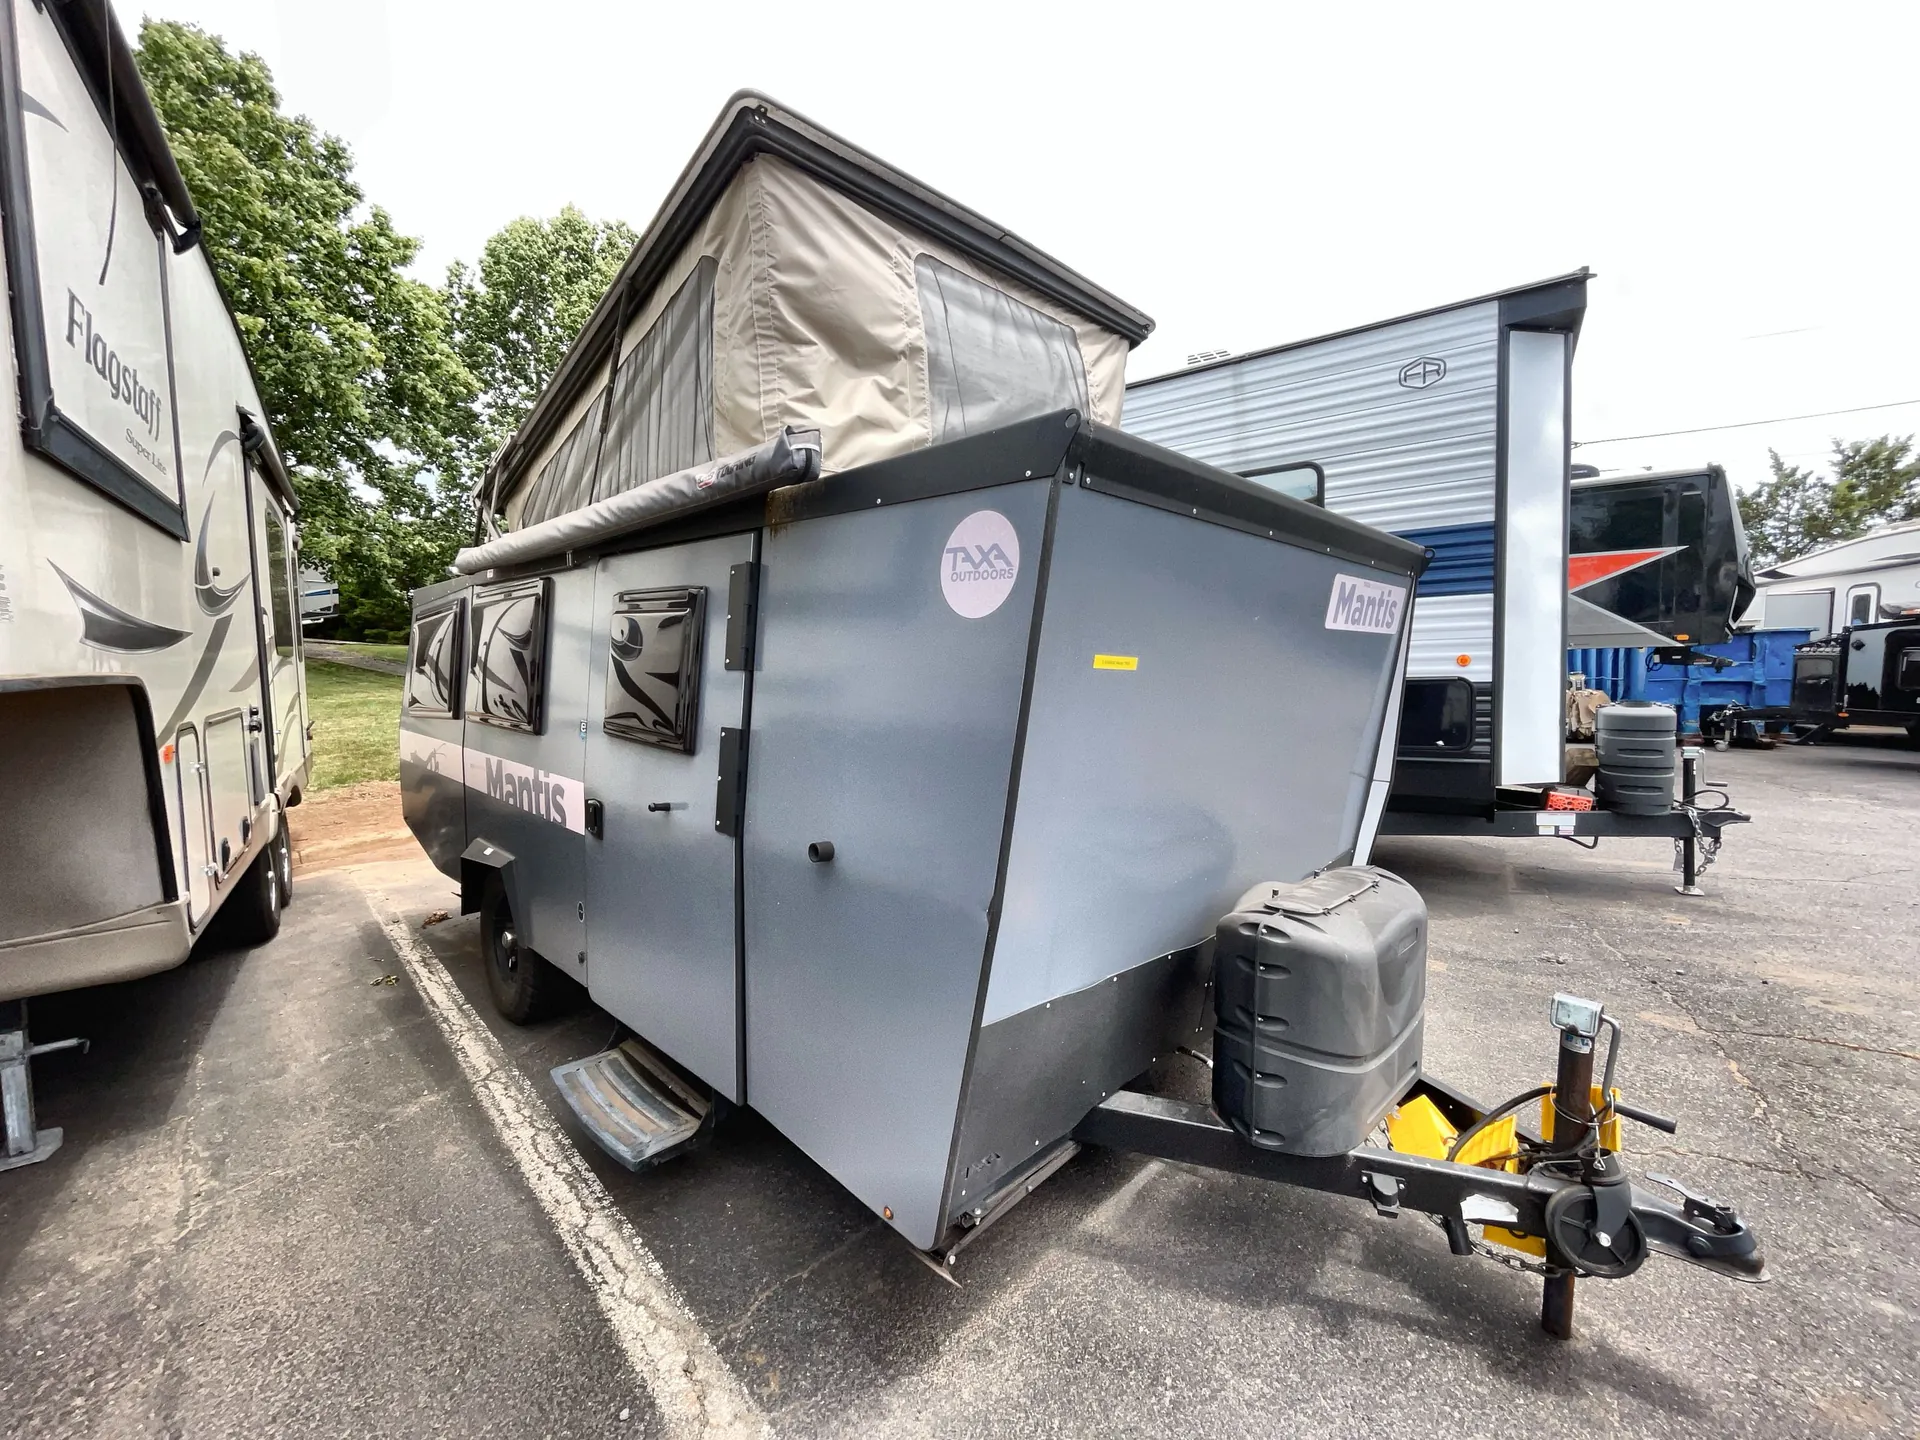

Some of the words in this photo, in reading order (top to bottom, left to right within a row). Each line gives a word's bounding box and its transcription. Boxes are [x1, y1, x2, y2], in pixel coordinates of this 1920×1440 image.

[66, 287, 162, 442] Flagstaff
[125, 428, 151, 461] Super
[151, 452, 168, 475] Lite
[946, 543, 1014, 571] TAXA
[951, 568, 1014, 582] OUTDOORS
[1333, 582, 1396, 629] Mantis
[485, 757, 567, 828] Mantis
